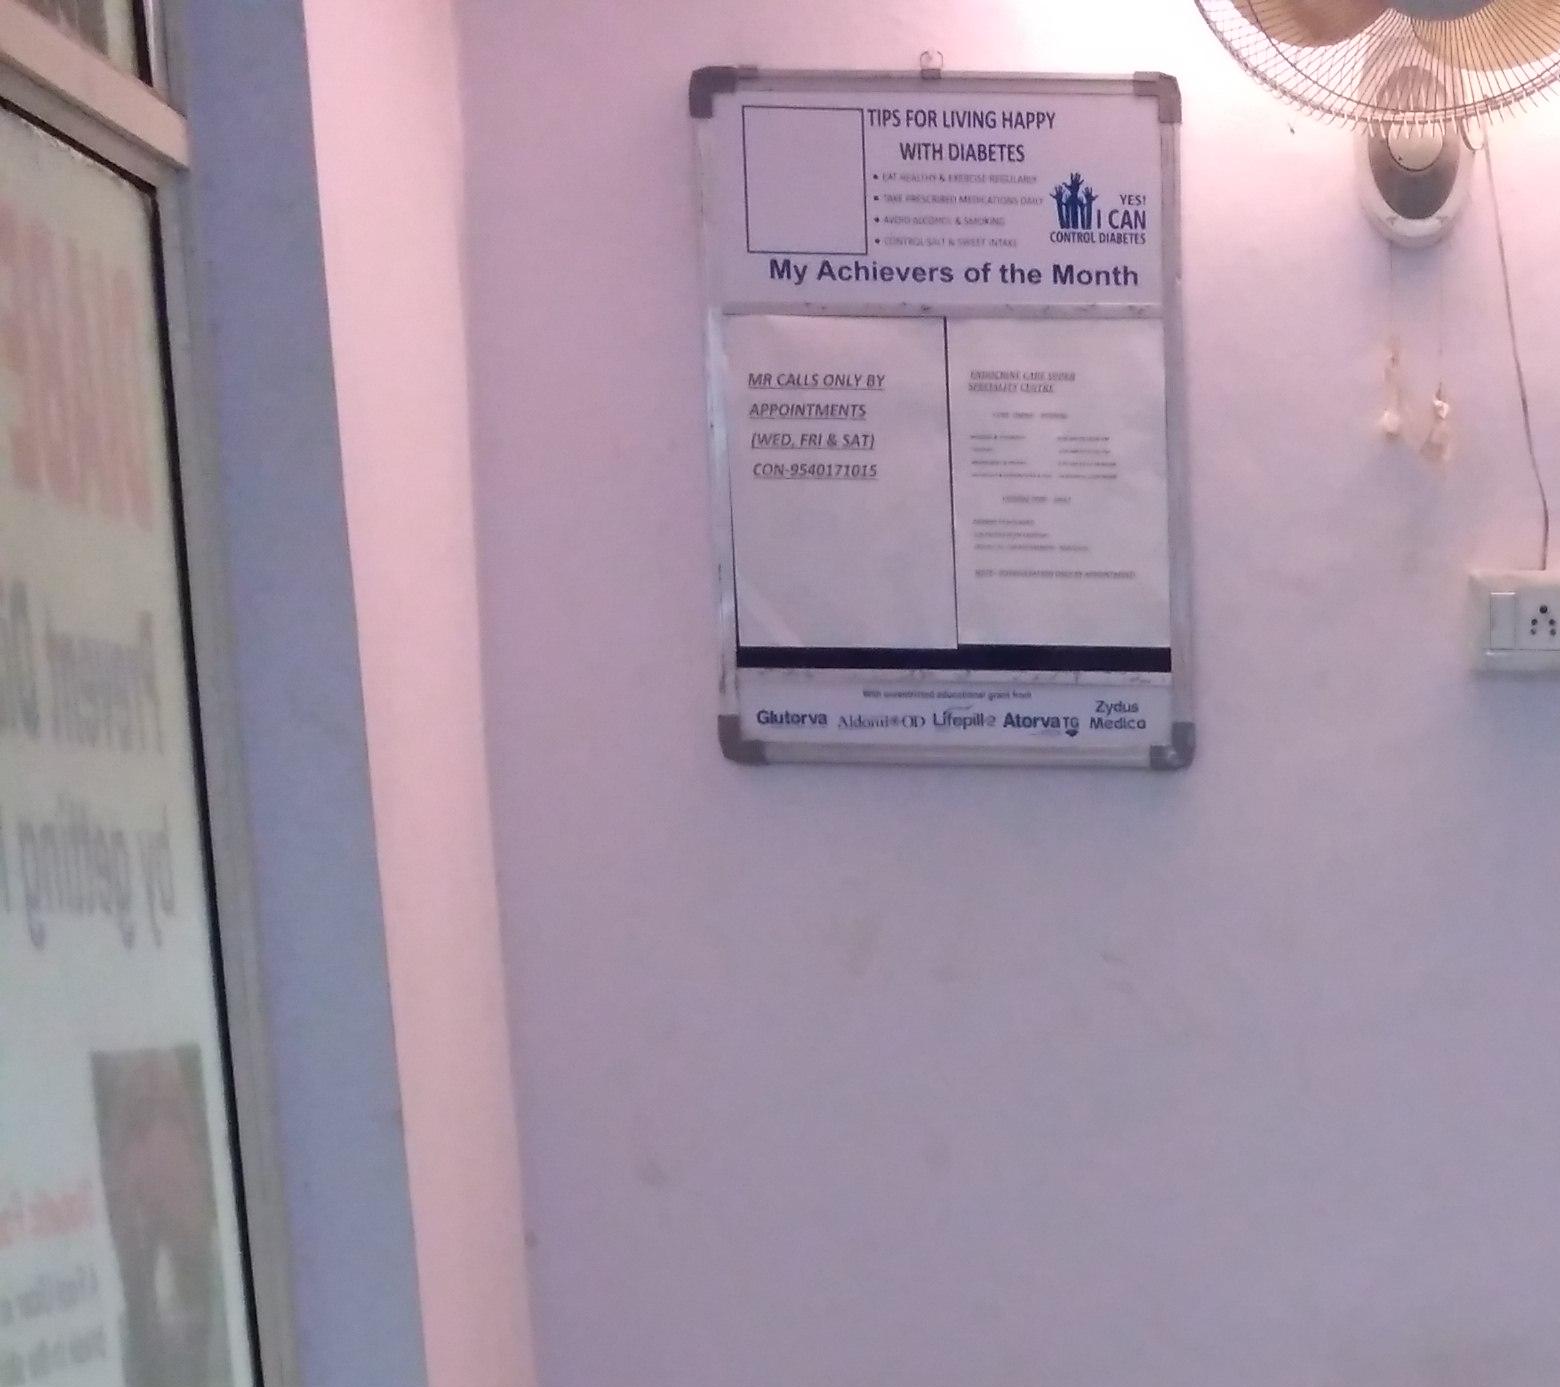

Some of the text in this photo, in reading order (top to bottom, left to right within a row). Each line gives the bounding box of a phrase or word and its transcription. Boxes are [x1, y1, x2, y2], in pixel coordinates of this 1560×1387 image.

[867, 109, 1056, 129] TIPS FOR LIVING HAPPY
[900, 143, 1025, 162] WITH DIABETES
[1119, 194, 1146, 206] YES!
[1097, 209, 1146, 230] I CAN
[1049, 231, 1146, 245] CONTROL DIABETES
[769, 258, 1138, 286] My Achievers of the Month
[748, 373, 886, 388] MR CALLS ONLY BY
[750, 403, 867, 418] APPOINTMENTS
[751, 432, 876, 450] (WED, FRI & SAT)
[1095, 700, 1139, 715] Zydus
[757, 710, 828, 726] Glutorva
[1003, 712, 1061, 729] Atorva
[1089, 717, 1146, 730] Medica
